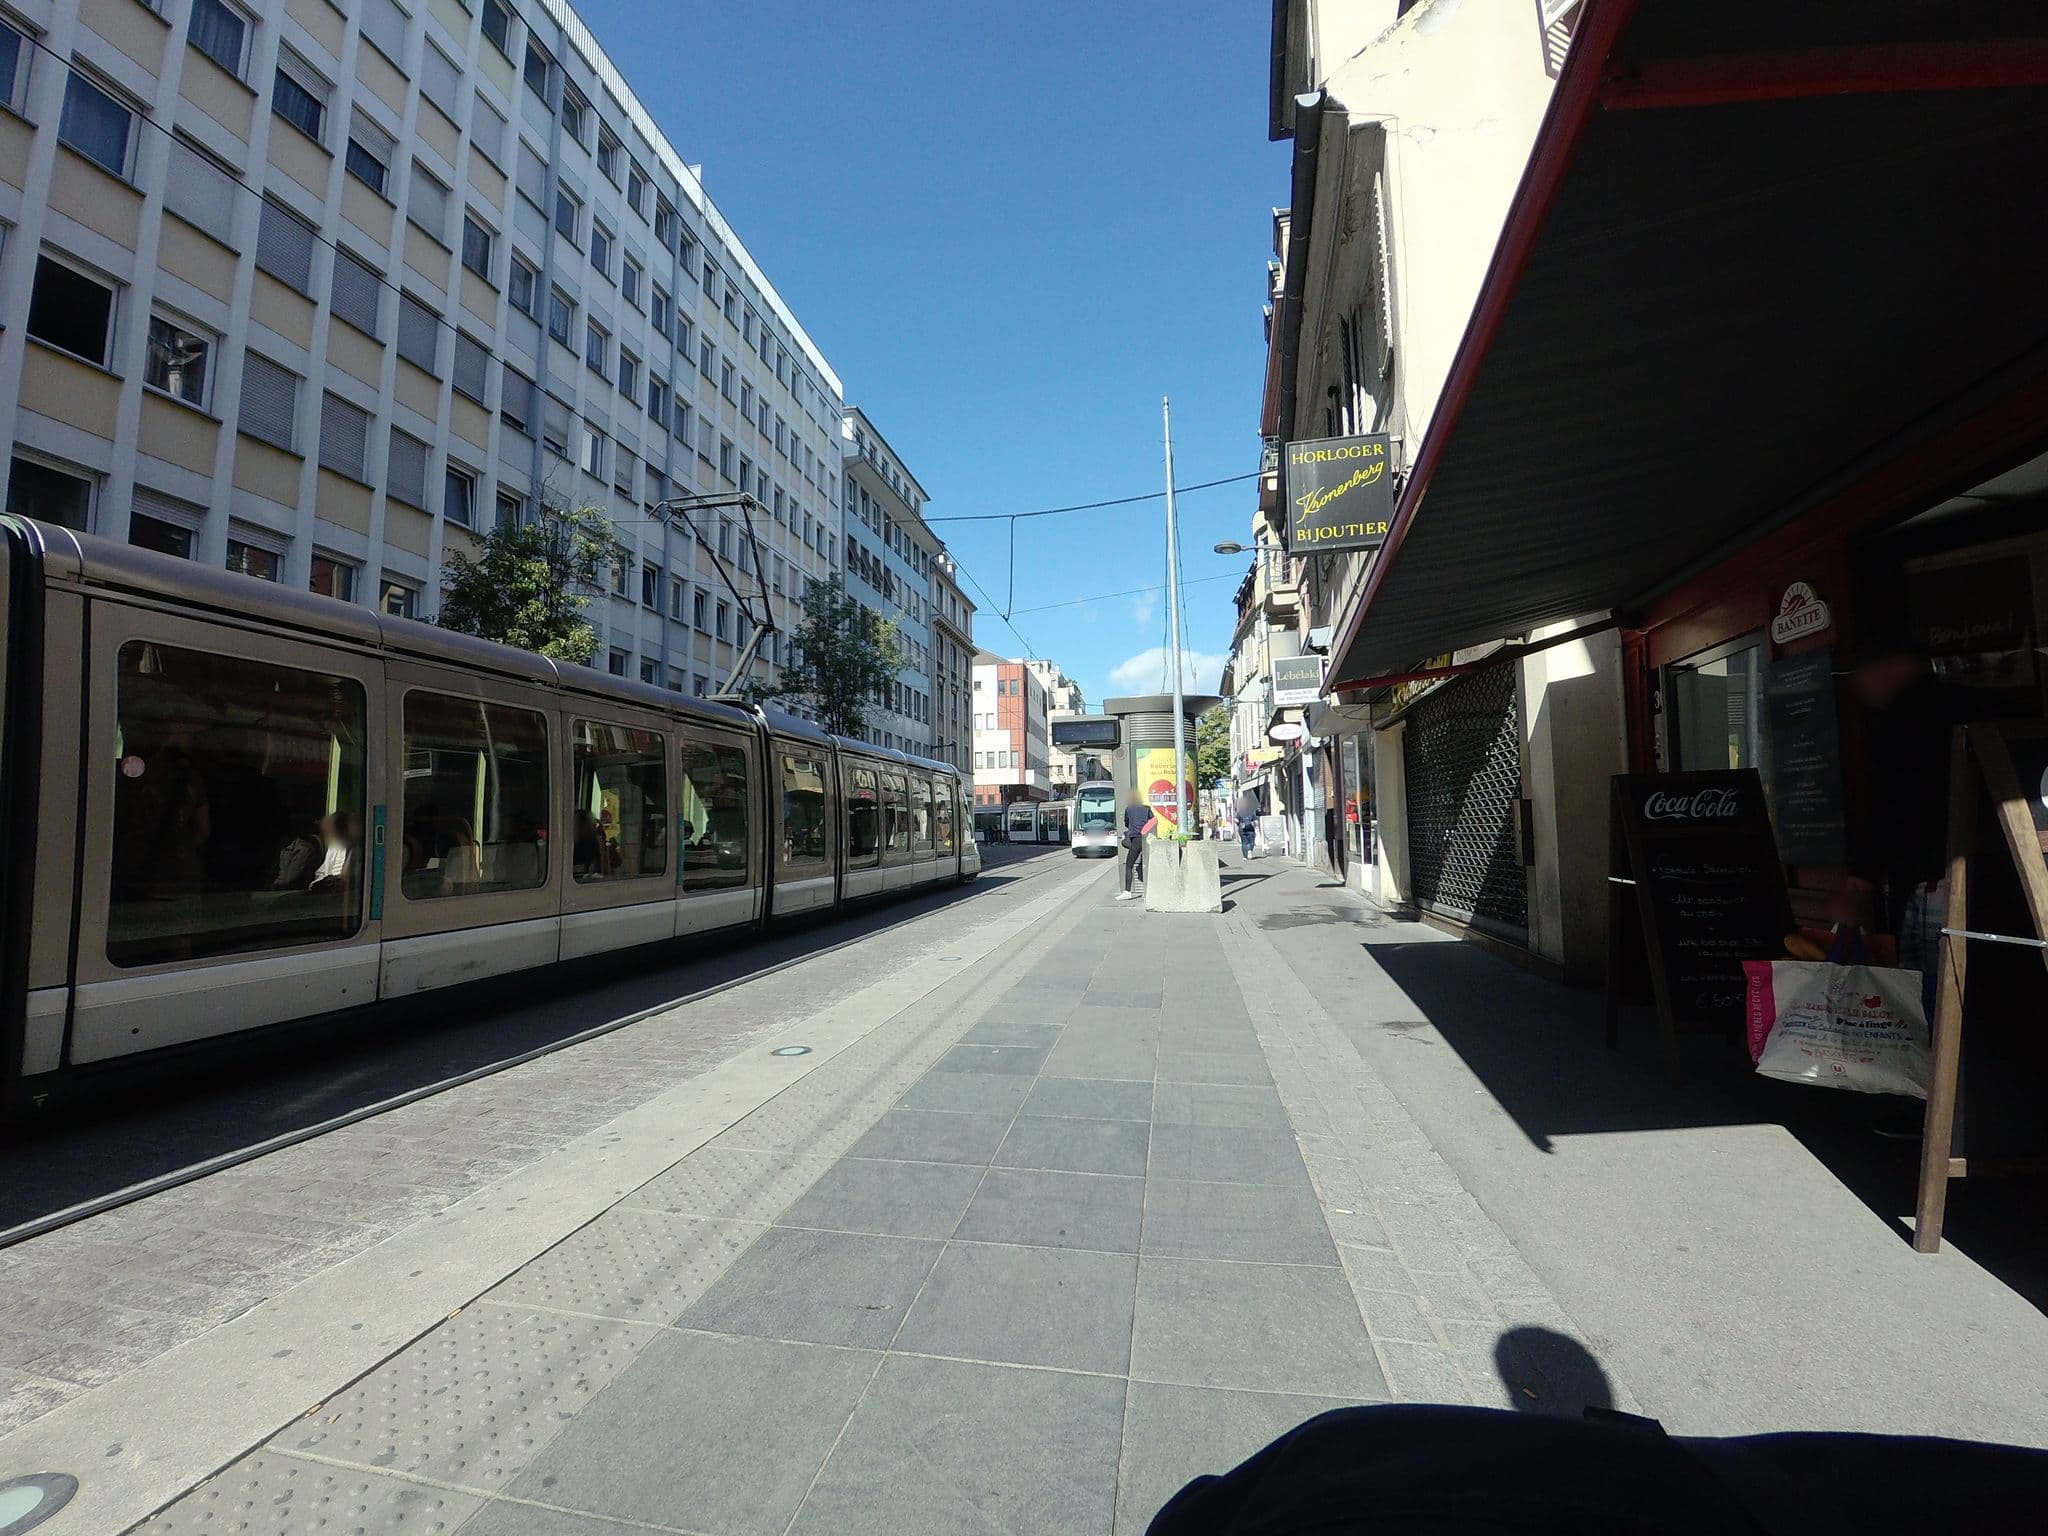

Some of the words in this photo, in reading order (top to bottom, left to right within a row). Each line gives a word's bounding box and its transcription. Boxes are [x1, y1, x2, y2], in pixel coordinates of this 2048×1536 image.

[1292, 443, 1384, 465] HORLOGER
[1296, 461, 1385, 524] Kronenberg
[1297, 522, 1388, 543] BIJOUTIER
[1777, 608, 1822, 634] BANETTE
